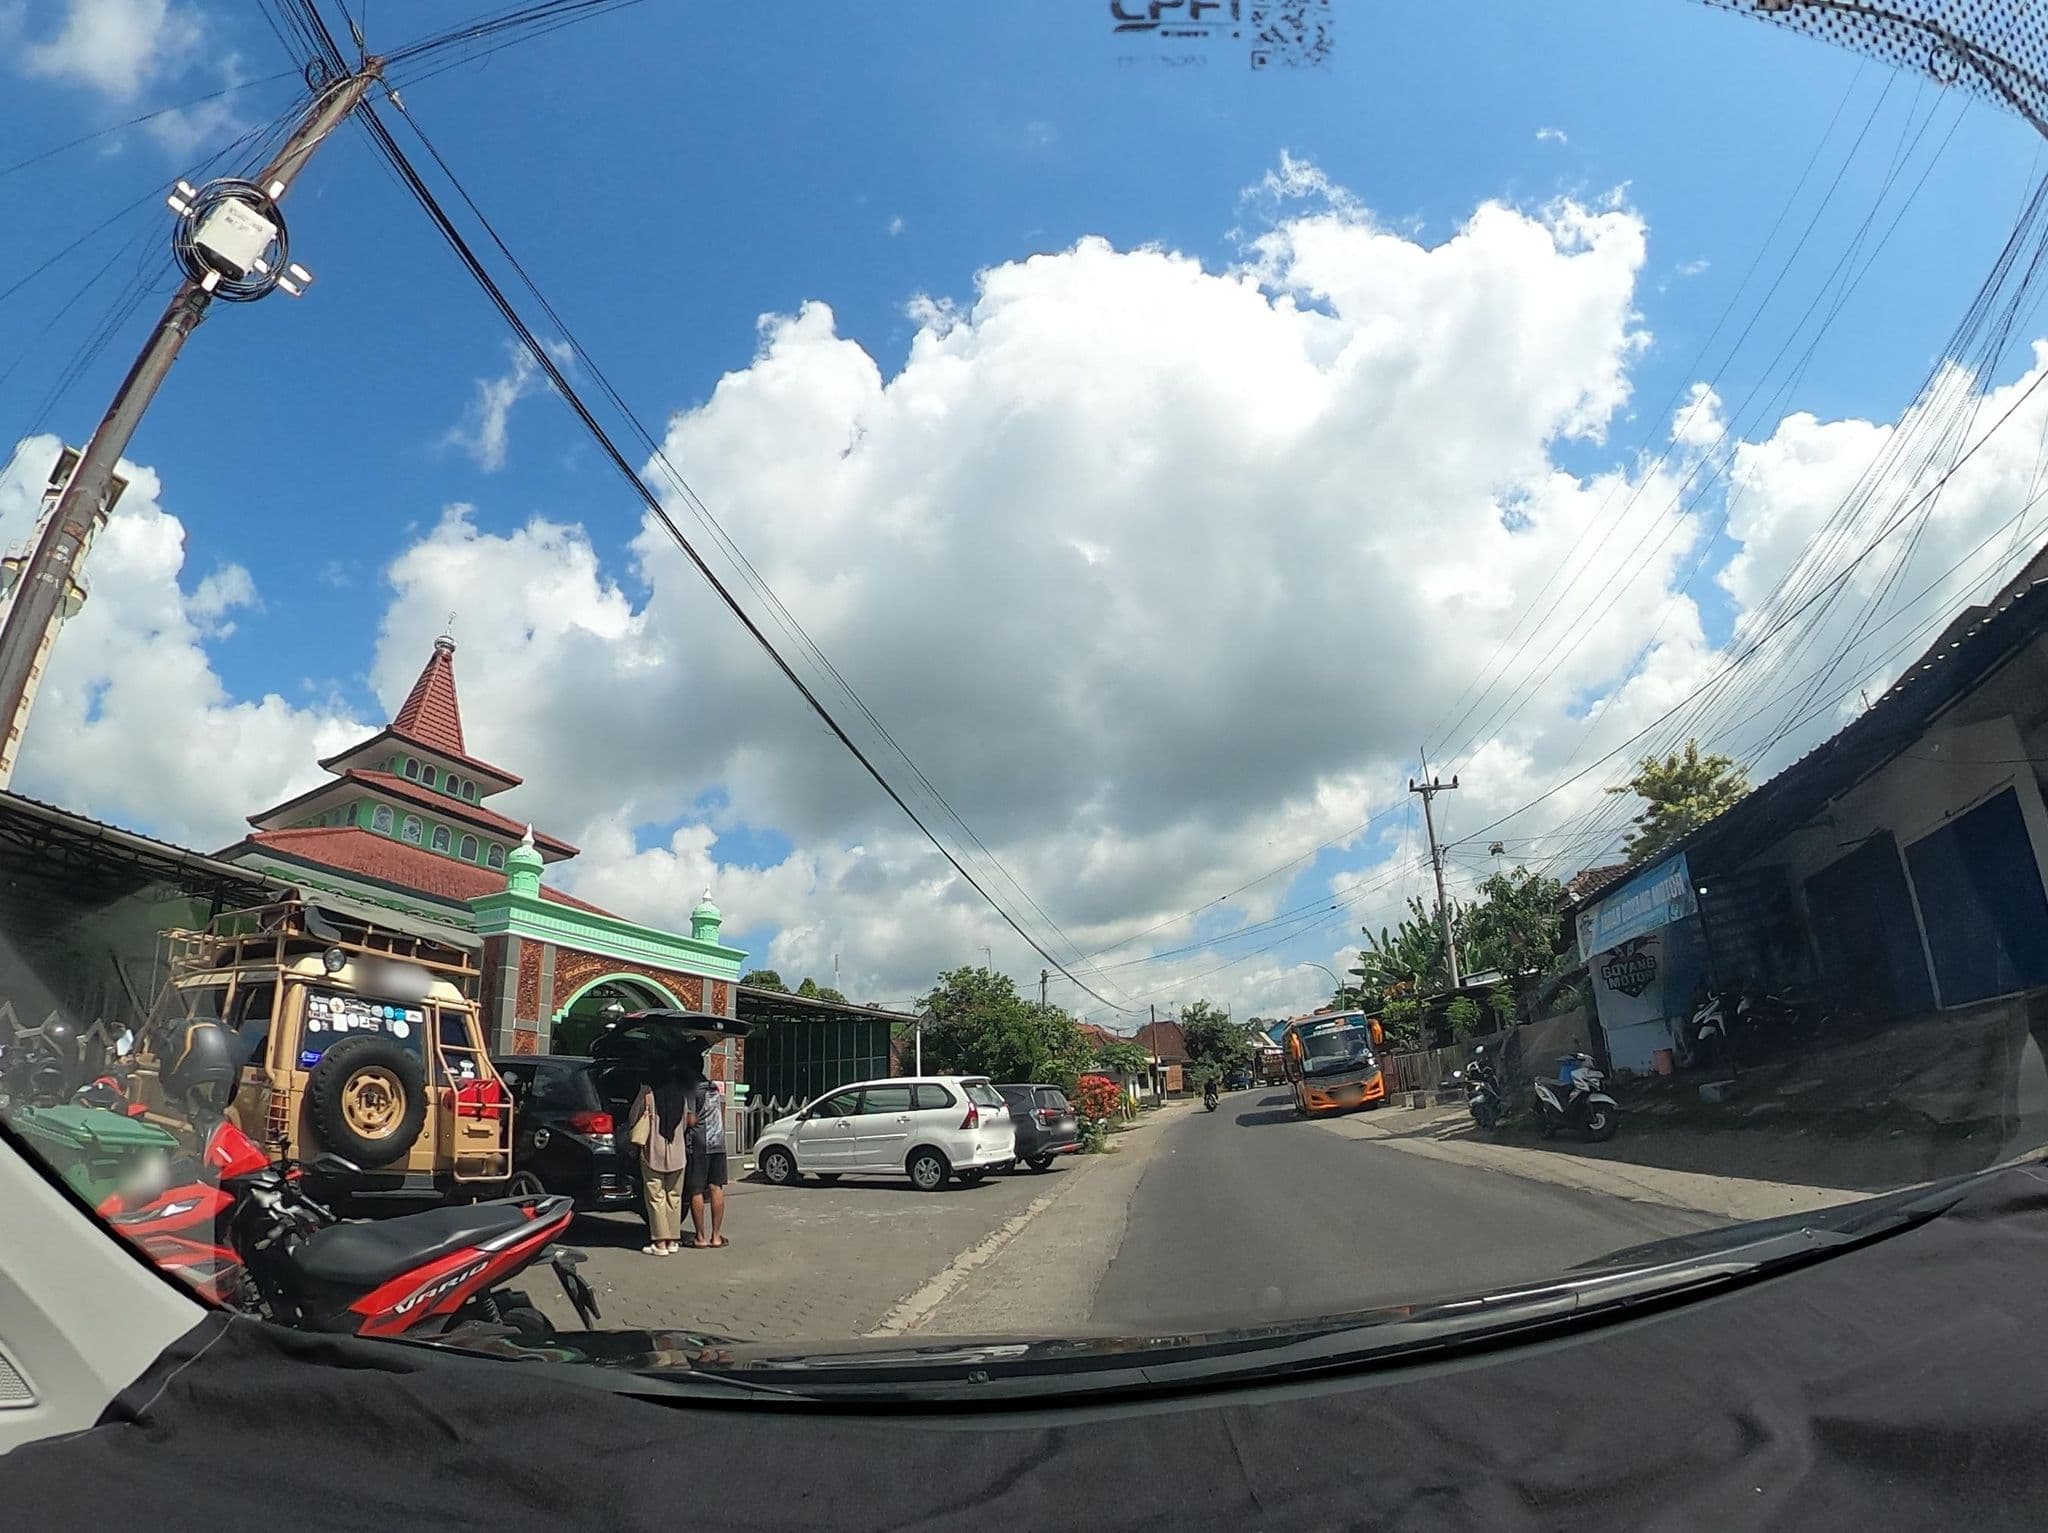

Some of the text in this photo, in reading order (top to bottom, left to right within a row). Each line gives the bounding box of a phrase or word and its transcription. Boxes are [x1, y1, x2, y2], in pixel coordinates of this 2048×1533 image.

[1602, 956, 1655, 979] GOYANG
[1608, 970, 1654, 988] MOTOR
[395, 1261, 489, 1314] VARIO
